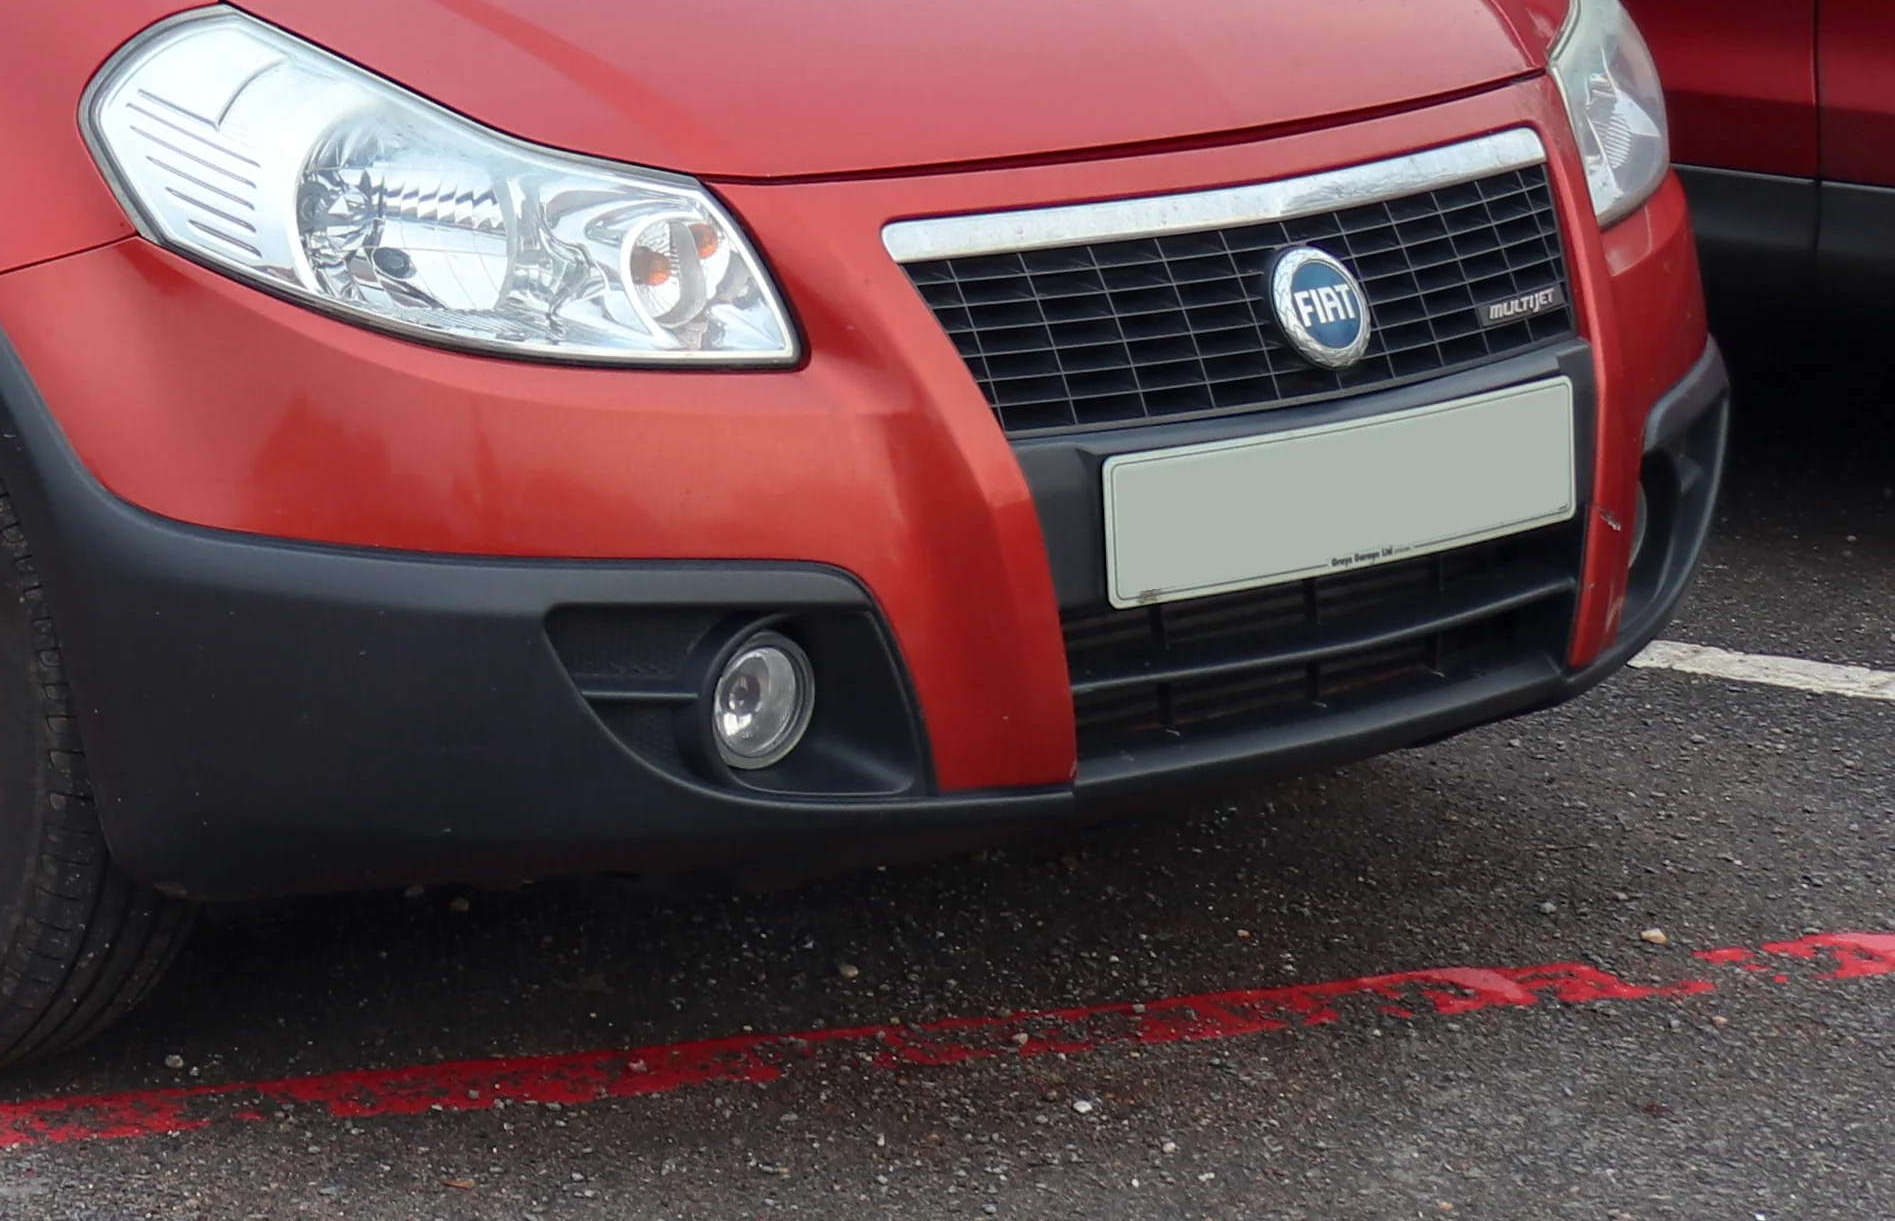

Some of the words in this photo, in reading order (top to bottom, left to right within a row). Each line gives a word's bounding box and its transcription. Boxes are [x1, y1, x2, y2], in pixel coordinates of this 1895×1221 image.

[1293, 283, 1356, 328] FIAT
[1489, 287, 1555, 320] MULTIJET
[1354, 551, 1381, 564] Garage
[1381, 544, 1393, 557] Ltd
